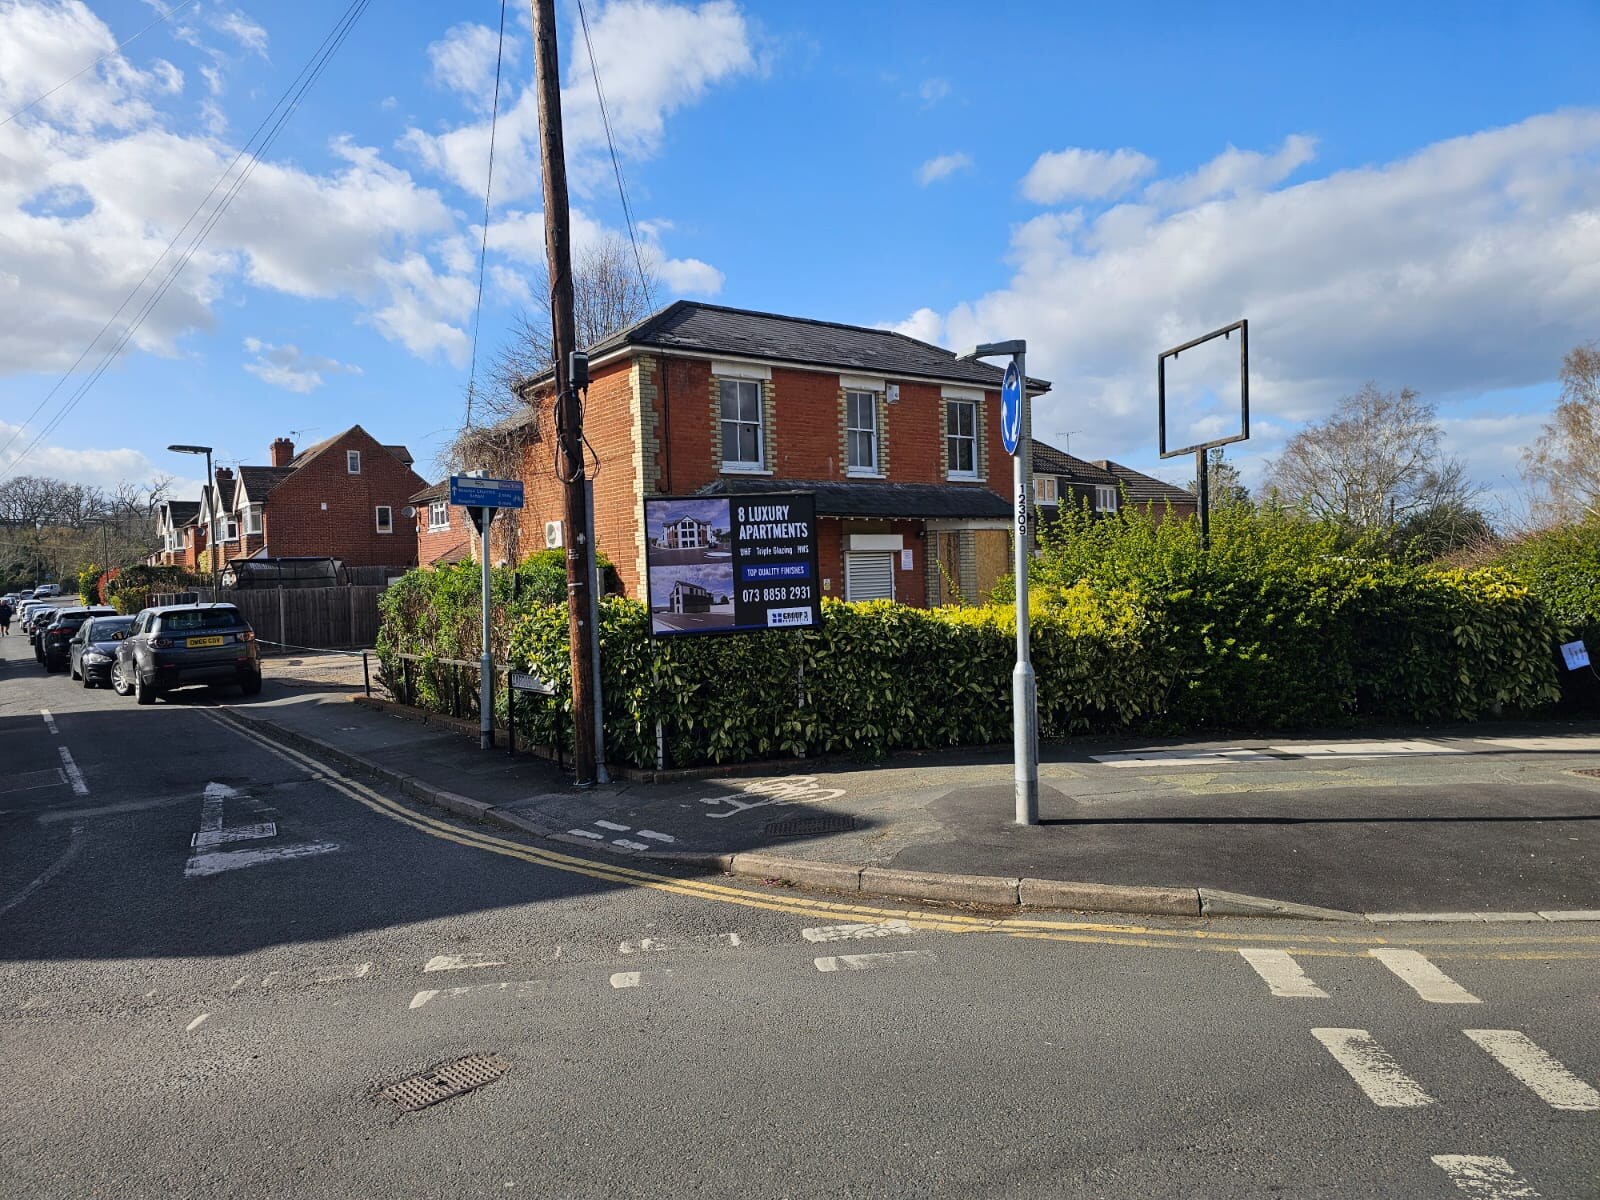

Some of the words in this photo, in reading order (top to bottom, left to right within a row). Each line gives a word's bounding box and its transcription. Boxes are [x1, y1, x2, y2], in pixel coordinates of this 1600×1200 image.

[738, 506, 745, 522] 8
[748, 505, 790, 522] LUXURY
[1017, 484, 1026, 535] 12309
[739, 522, 808, 540] APARTMENTS
[756, 546, 772, 557] Triple
[772, 545, 793, 556] Glazing
[747, 568, 758, 577] TOP
[758, 567, 780, 577] QUALITY
[781, 566, 805, 575] FINISHES
[742, 589, 760, 603] 073
[763, 587, 786, 602] 8858
[789, 585, 810, 600] 2931
